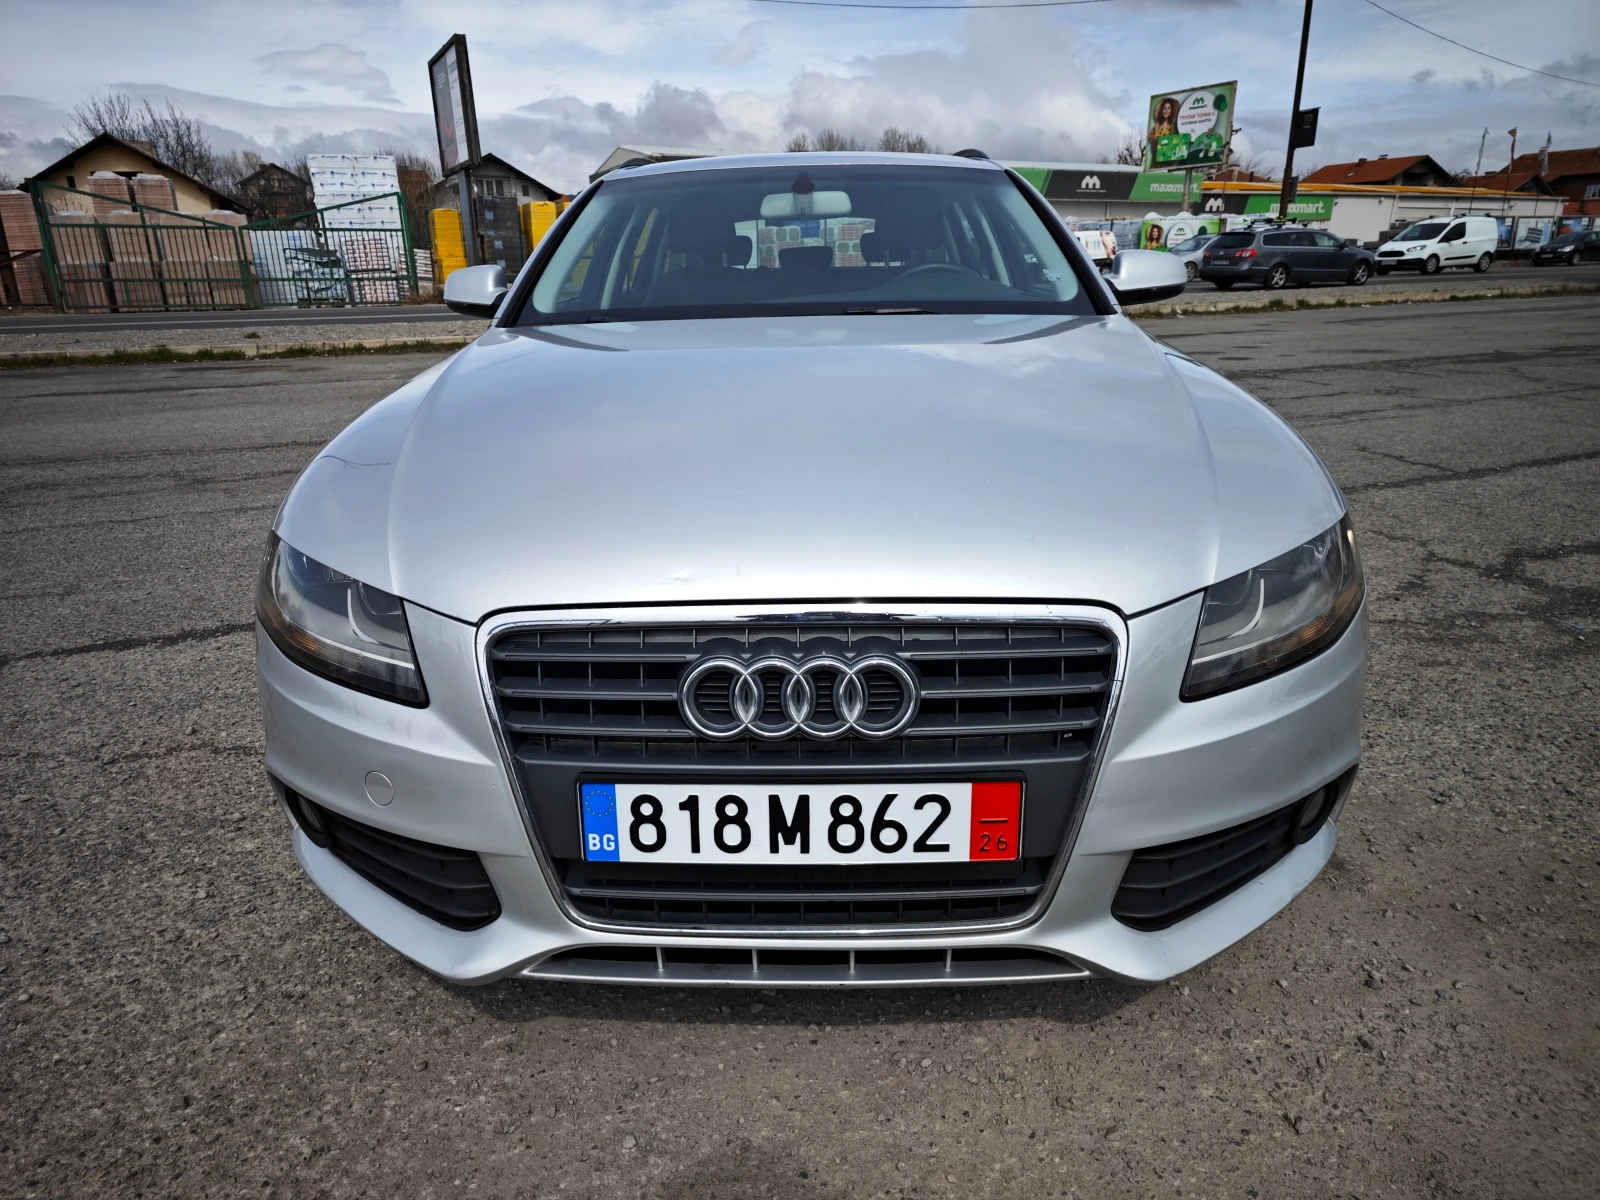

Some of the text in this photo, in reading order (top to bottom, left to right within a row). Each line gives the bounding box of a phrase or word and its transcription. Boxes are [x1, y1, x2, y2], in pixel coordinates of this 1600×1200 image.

[1149, 182, 1200, 193] maxxmrt.
[1269, 201, 1325, 213] mxxmart.
[588, 833, 616, 851] BG
[980, 832, 1008, 852] 26
